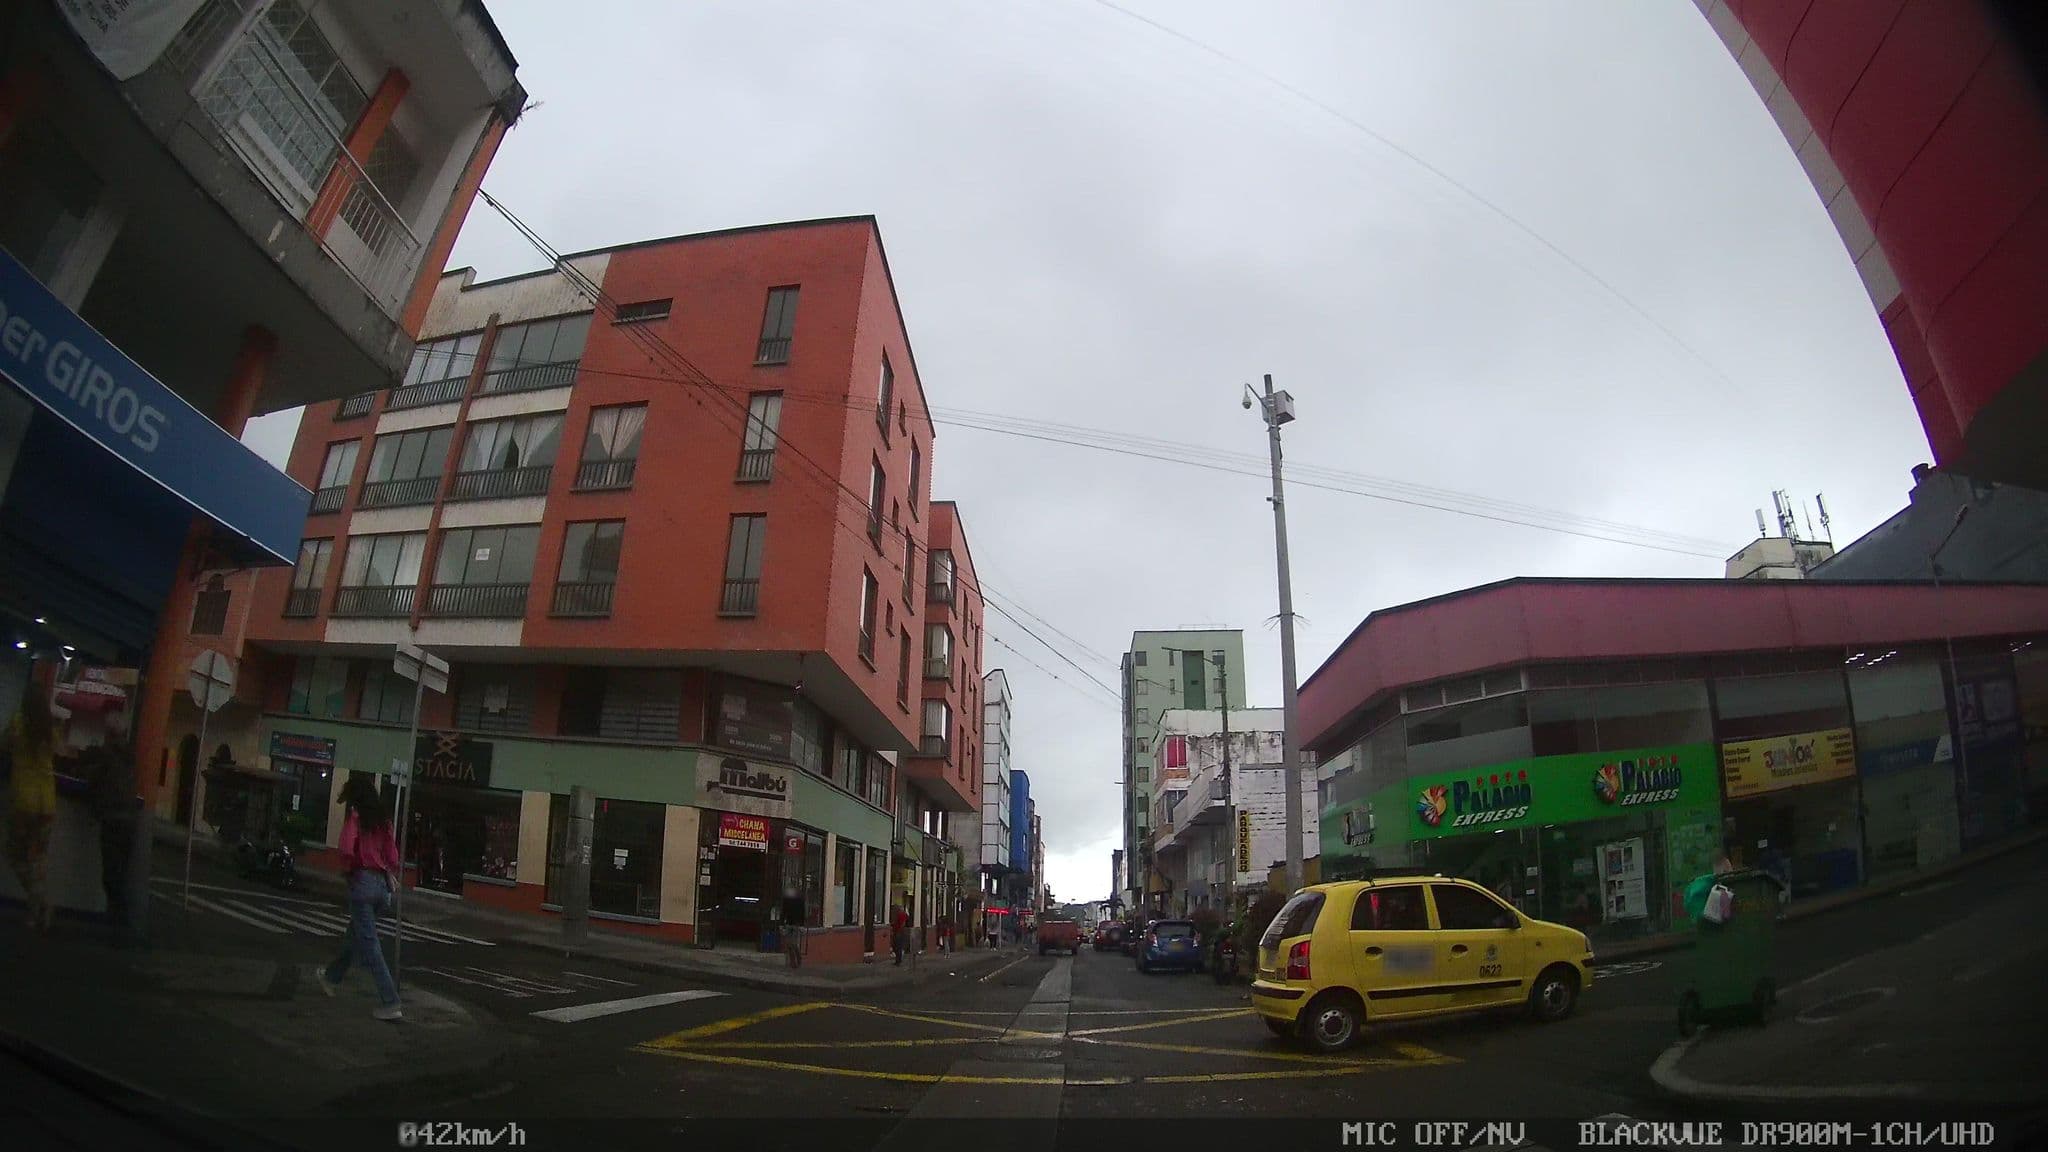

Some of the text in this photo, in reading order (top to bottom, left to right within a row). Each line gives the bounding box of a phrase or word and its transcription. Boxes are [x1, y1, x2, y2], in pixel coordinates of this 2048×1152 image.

[46, 341, 166, 452] GIROS
[1452, 806, 1529, 827] EXPRESS
[1620, 788, 1680, 805] EXPRESS
[1239, 810, 1248, 871] PARQUEADERO
